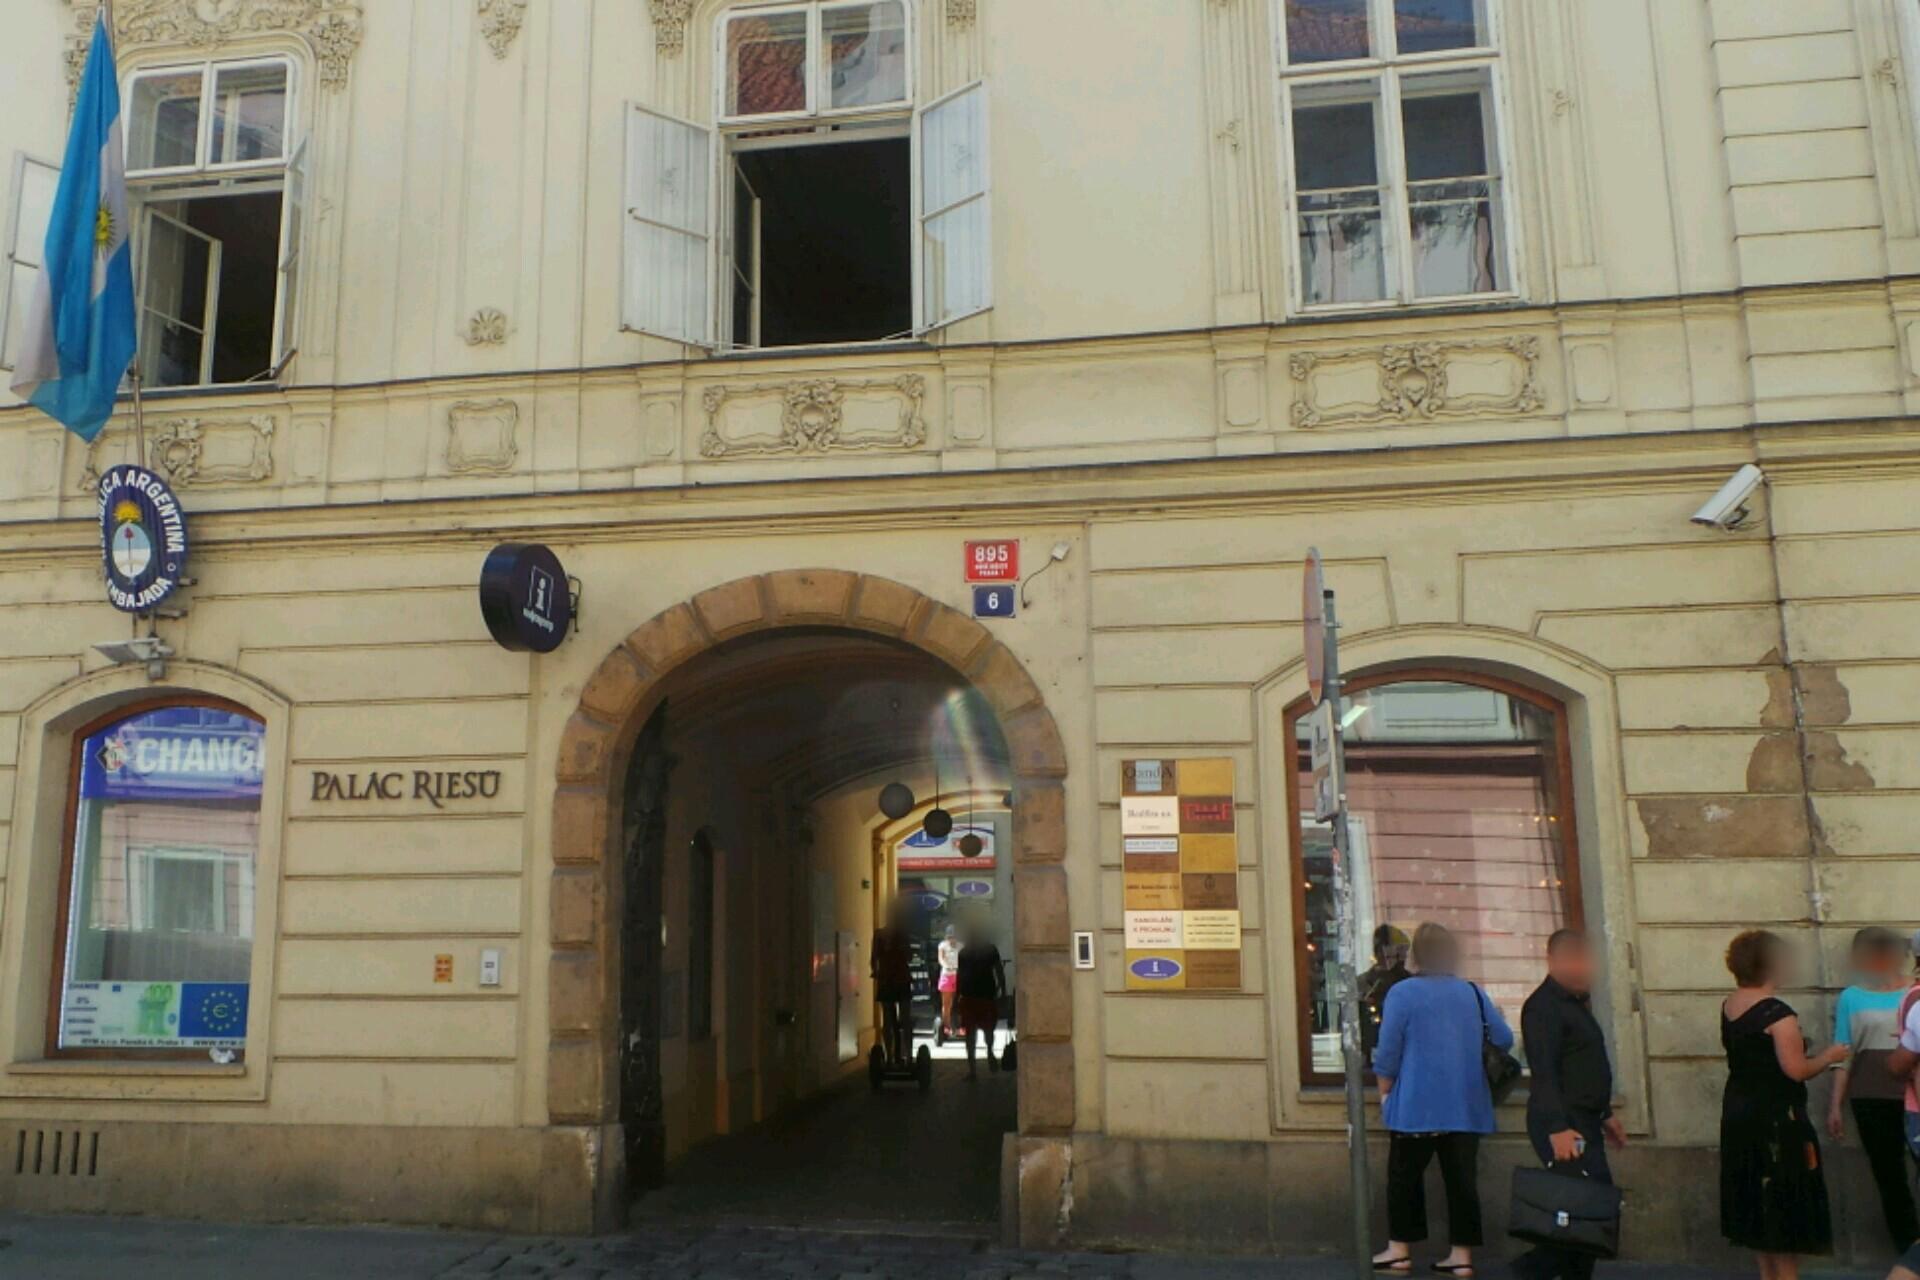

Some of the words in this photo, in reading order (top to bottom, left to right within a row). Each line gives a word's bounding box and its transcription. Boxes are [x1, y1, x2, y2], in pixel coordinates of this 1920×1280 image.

[125, 469, 185, 554] ARGENTINA
[975, 545, 1008, 562] 895
[106, 576, 173, 609] EMBAJADA
[988, 592, 999, 610] 6
[311, 770, 404, 801] PALÁC
